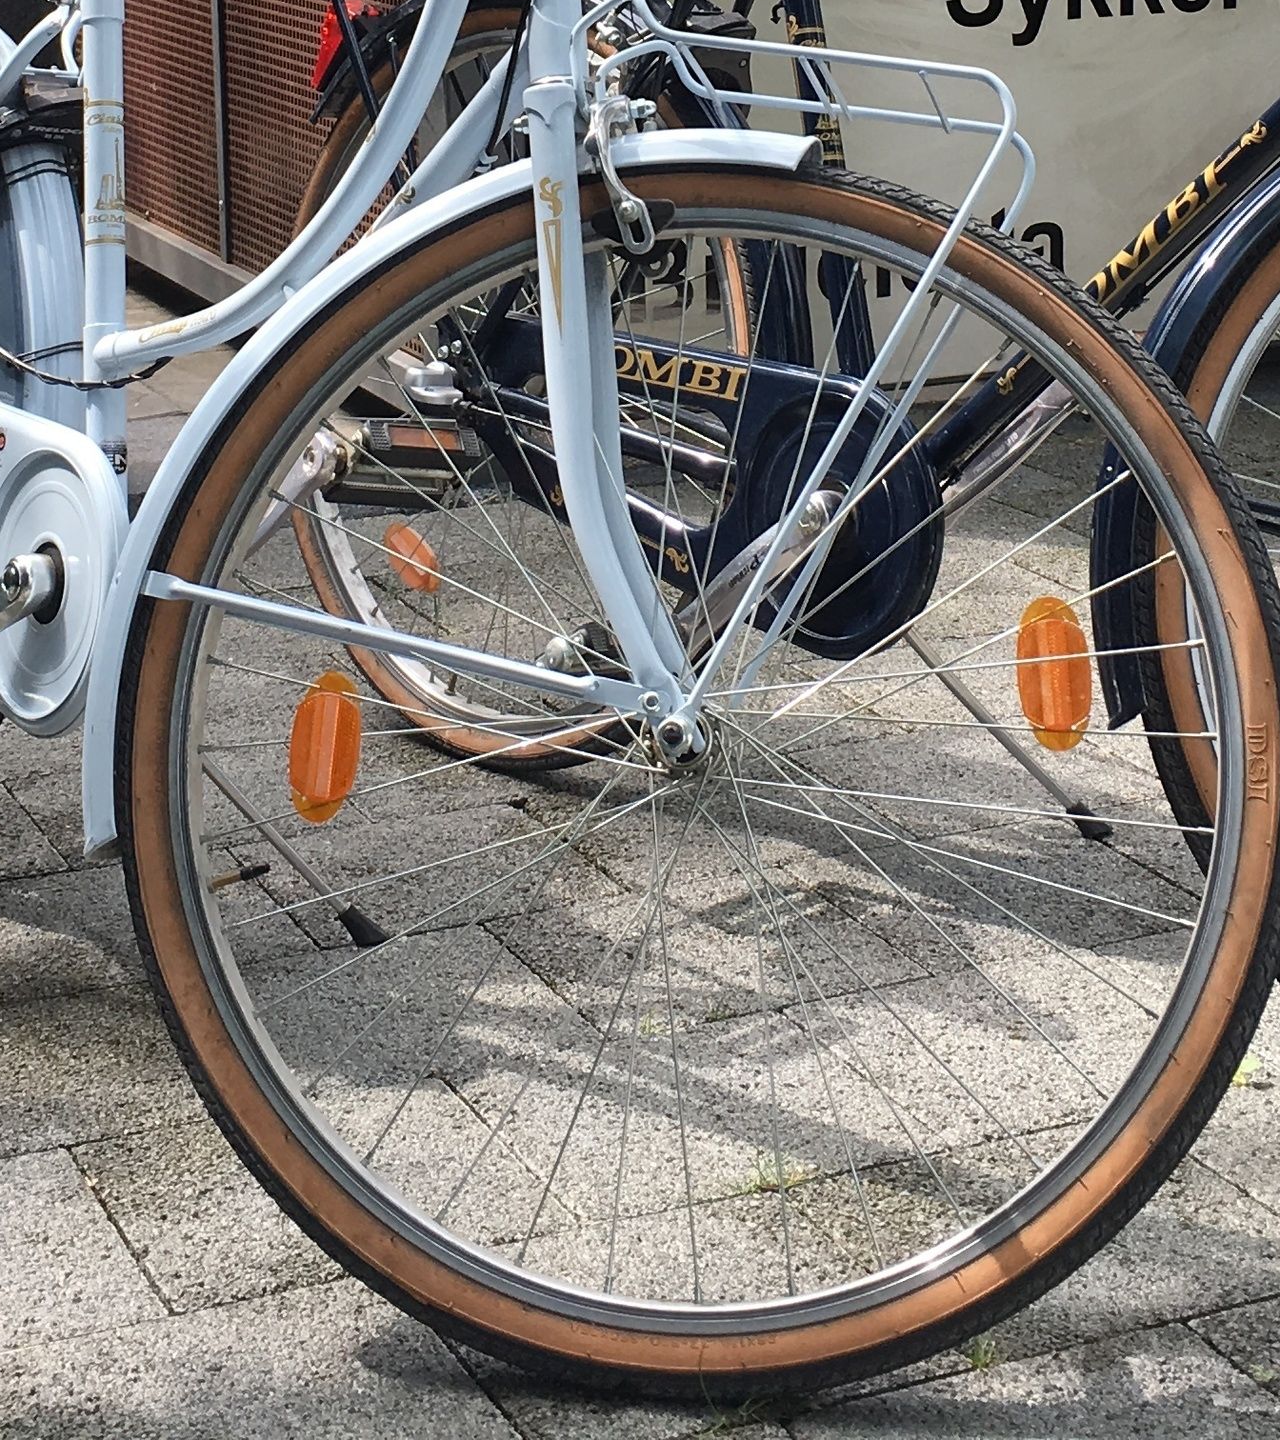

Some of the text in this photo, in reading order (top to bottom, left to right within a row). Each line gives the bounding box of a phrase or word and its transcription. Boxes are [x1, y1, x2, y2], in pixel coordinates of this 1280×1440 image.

[28, 124, 83, 135] TRELOC
[87, 214, 127, 225] BOM
[1084, 155, 1227, 304] OMBI
[615, 345, 748, 402] OMBI
